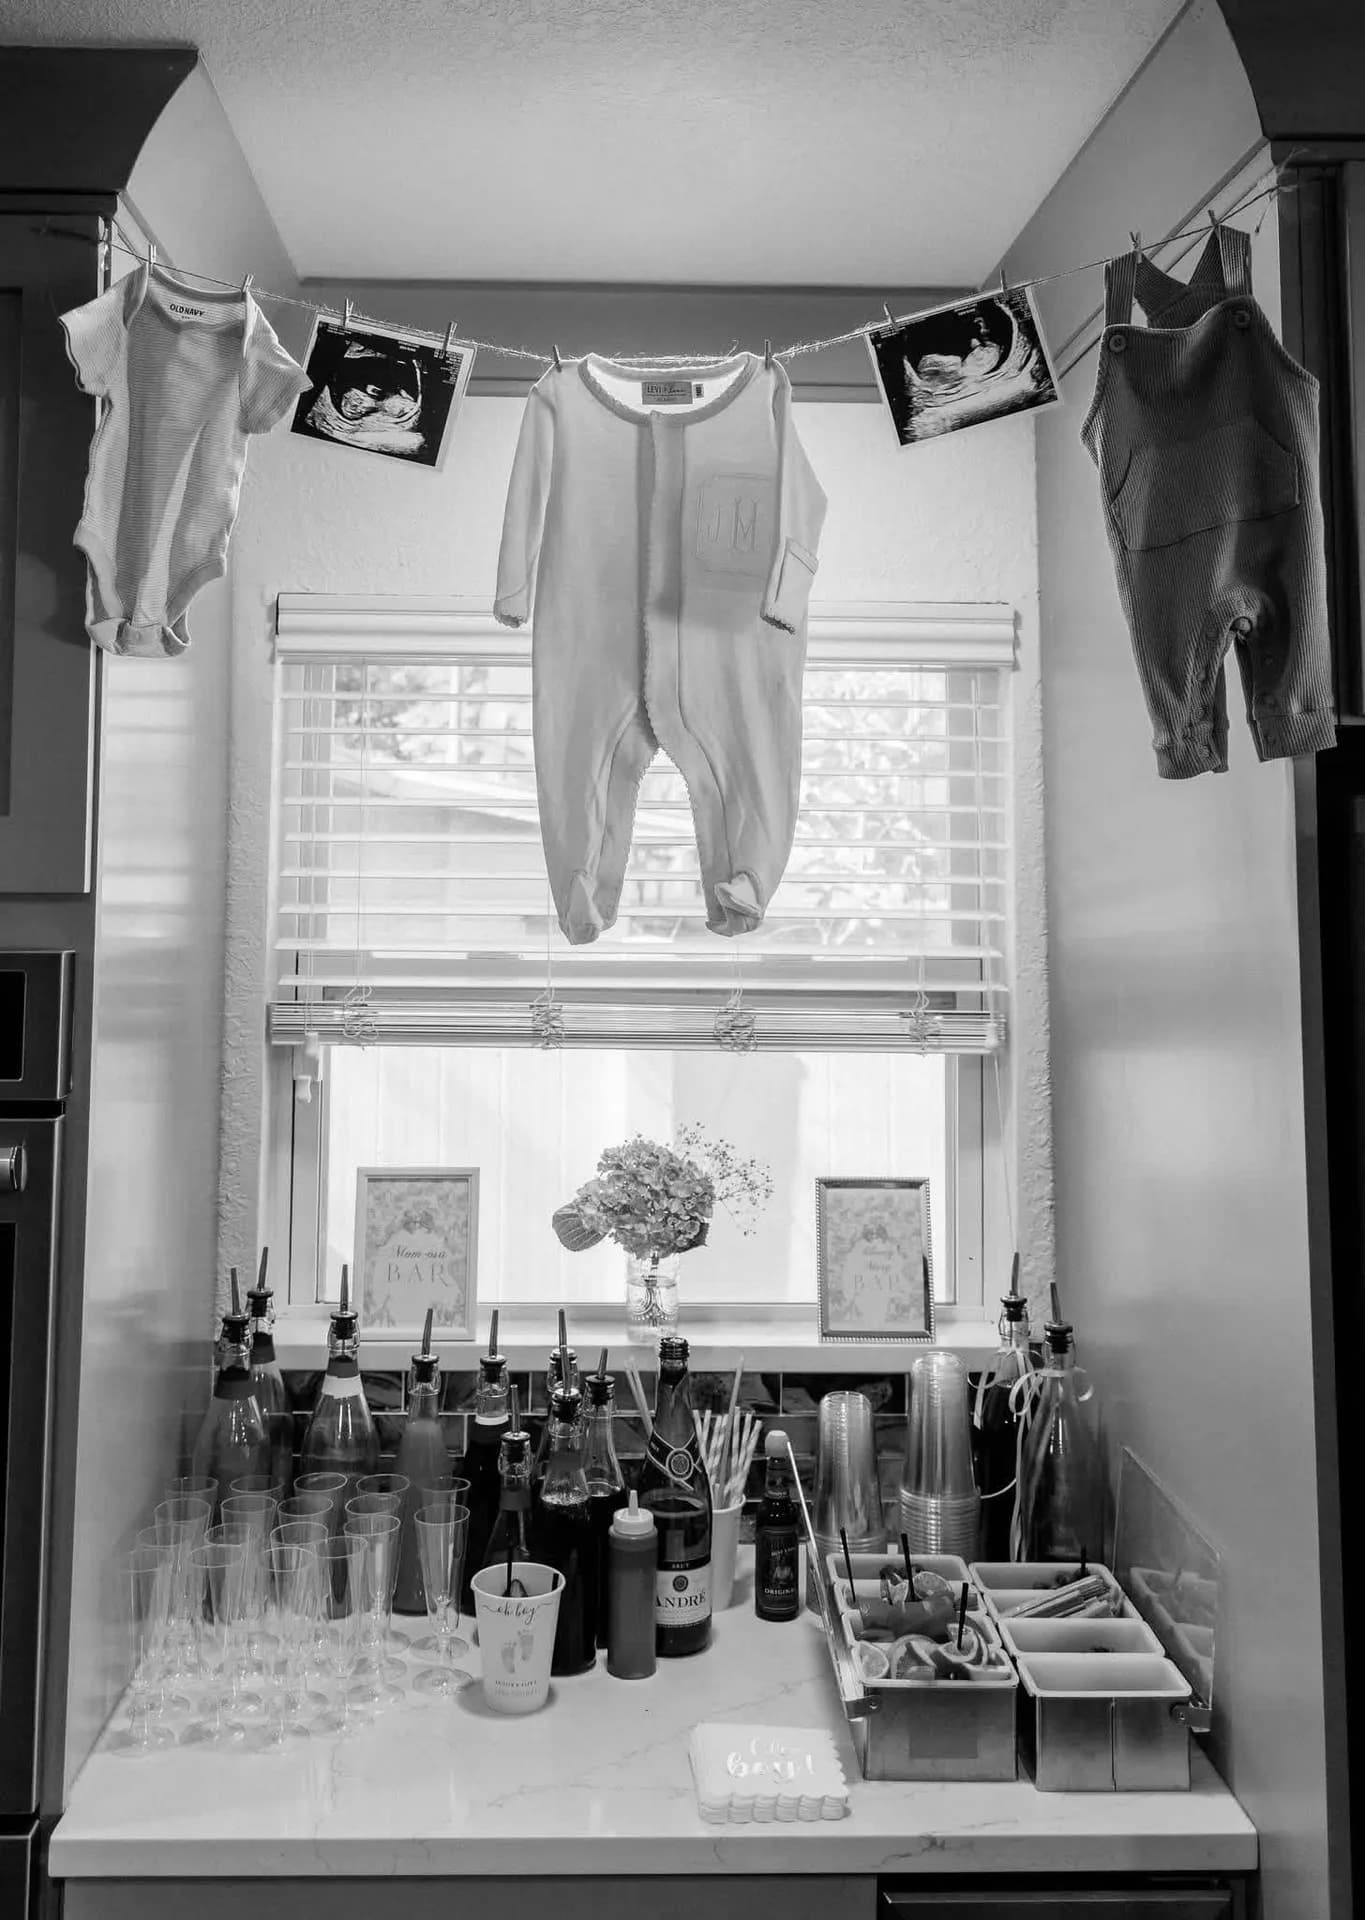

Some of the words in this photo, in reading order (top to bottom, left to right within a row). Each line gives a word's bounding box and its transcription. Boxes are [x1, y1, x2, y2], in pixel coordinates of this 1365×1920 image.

[169, 303, 184, 314] OLD
[185, 306, 206, 317] NAVY
[387, 1263, 450, 1288] BAR
[514, 1601, 540, 1626] boy
